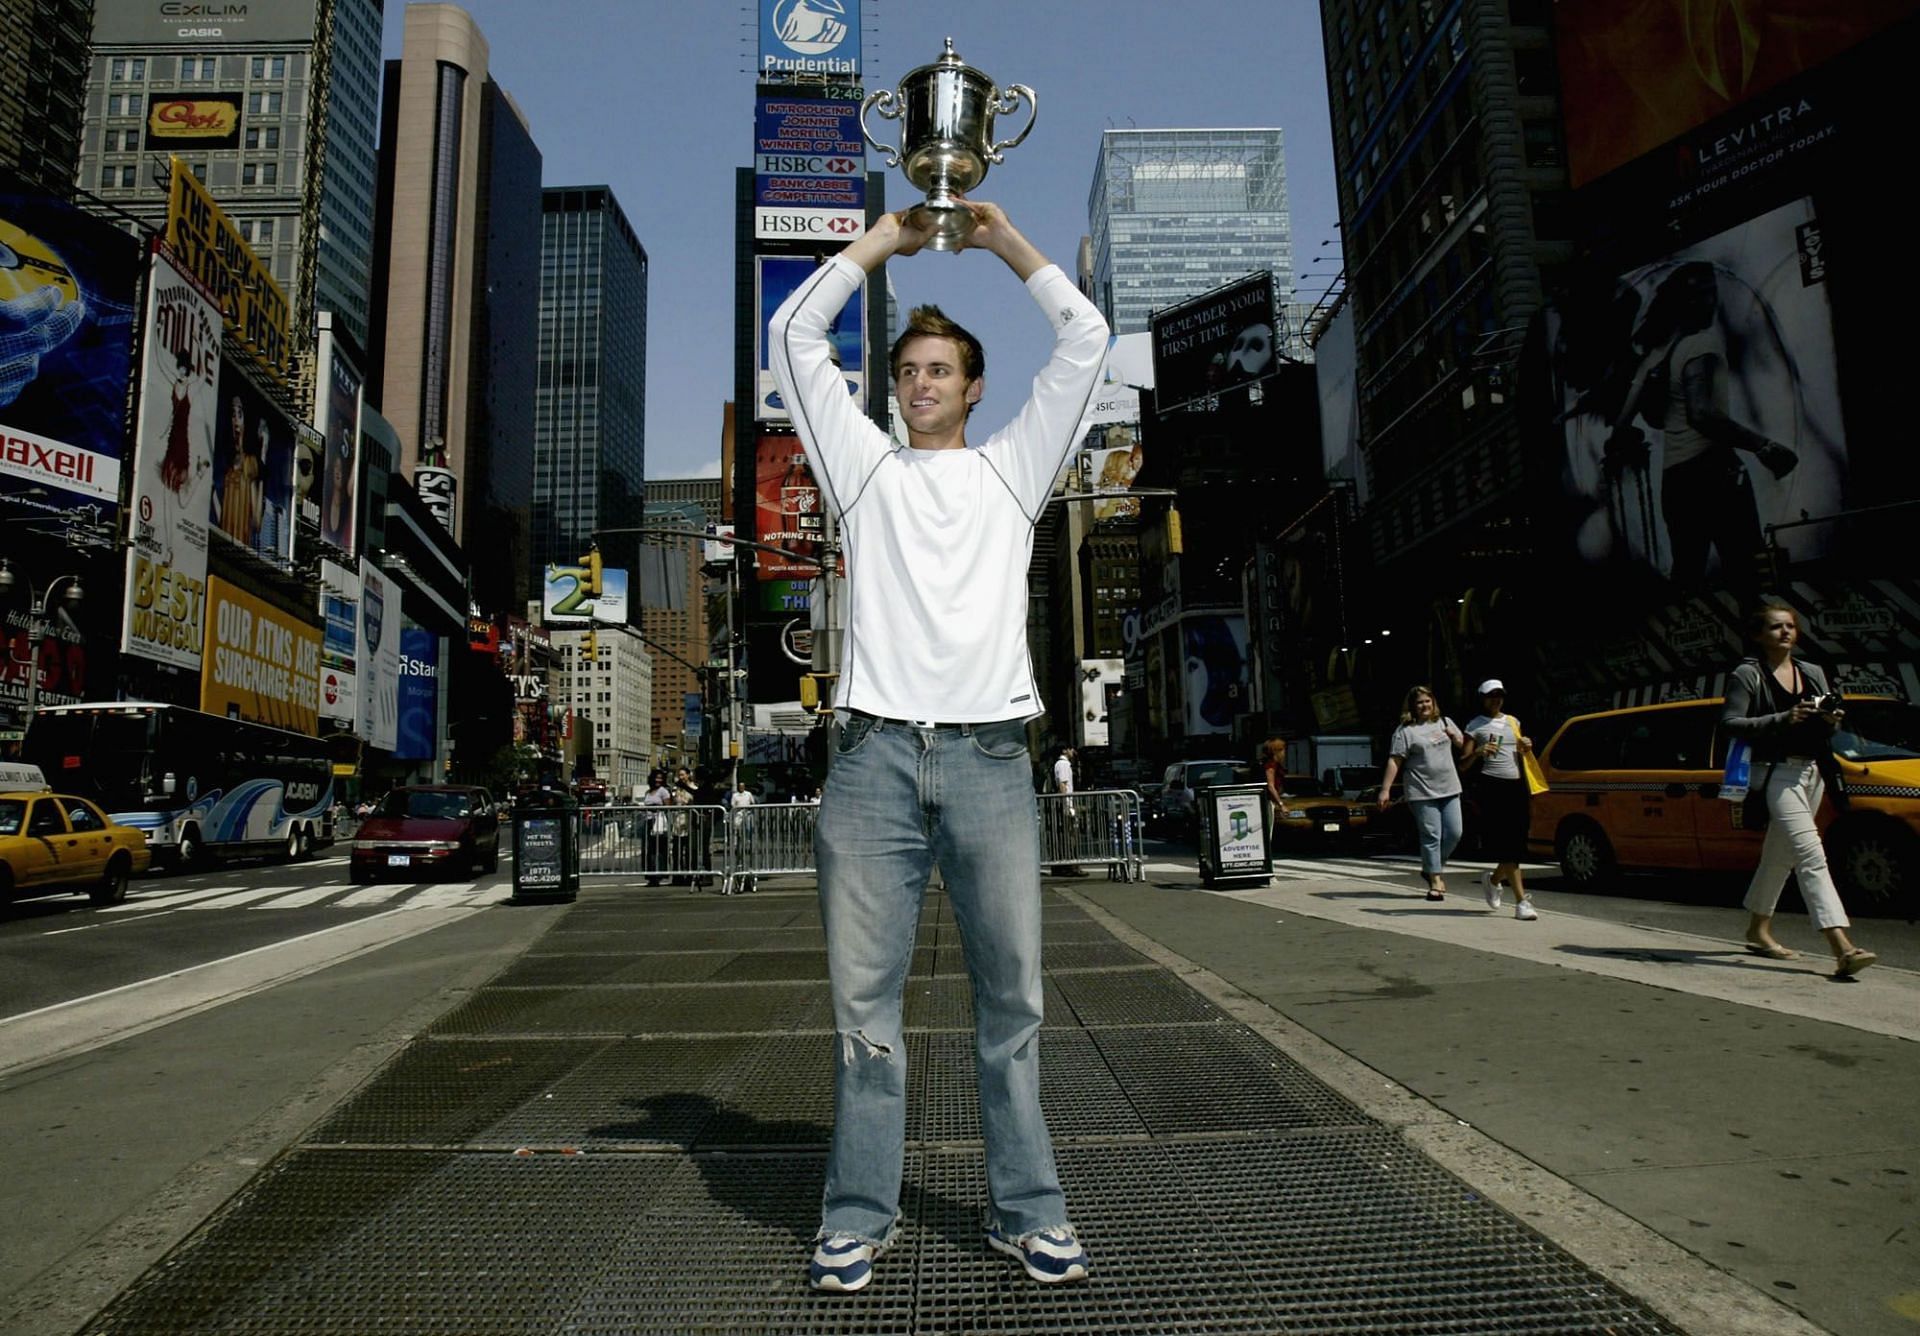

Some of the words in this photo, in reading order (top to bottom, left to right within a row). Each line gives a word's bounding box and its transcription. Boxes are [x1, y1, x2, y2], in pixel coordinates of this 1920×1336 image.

[178, 28, 222, 37] CASIO
[764, 55, 856, 73] Prudential
[823, 88, 863, 100] 12:46
[766, 103, 855, 117] INTRODUCING
[782, 115, 839, 127] JOHNNIE
[1699, 98, 1812, 164] LEVITRA
[760, 140, 811, 150] WINNER
[814, 141, 832, 152] OF
[835, 142, 861, 153] THE
[764, 156, 822, 173] HSBC
[1668, 190, 1692, 208] ASK
[1696, 174, 1729, 196] YOUR
[1732, 148, 1784, 180] DOCTOR
[180, 174, 212, 243] THE
[761, 215, 824, 233] HSBC
[176, 216, 241, 327] STOPS
[246, 295, 287, 373] HERE
[1161, 303, 1227, 340] REMEMBER
[1230, 288, 1266, 313] YOUR
[1162, 333, 1194, 358] FIRST
[140, 496, 152, 521] 6
[763, 531, 804, 541] NOTHING
[806, 532, 825, 543] ELS
[135, 559, 203, 627] BEST
[548, 565, 594, 615] 2
[132, 609, 201, 656] MUSICAL
[216, 599, 252, 653] OUR
[255, 616, 292, 669] ATMS
[295, 636, 319, 680] ARE
[19, 664, 47, 682] LIE!
[214, 645, 319, 711] SURCHARGE-FREE
[284, 781, 319, 800] ACADEMY
[1223, 844, 1260, 852] ADVERTISE
